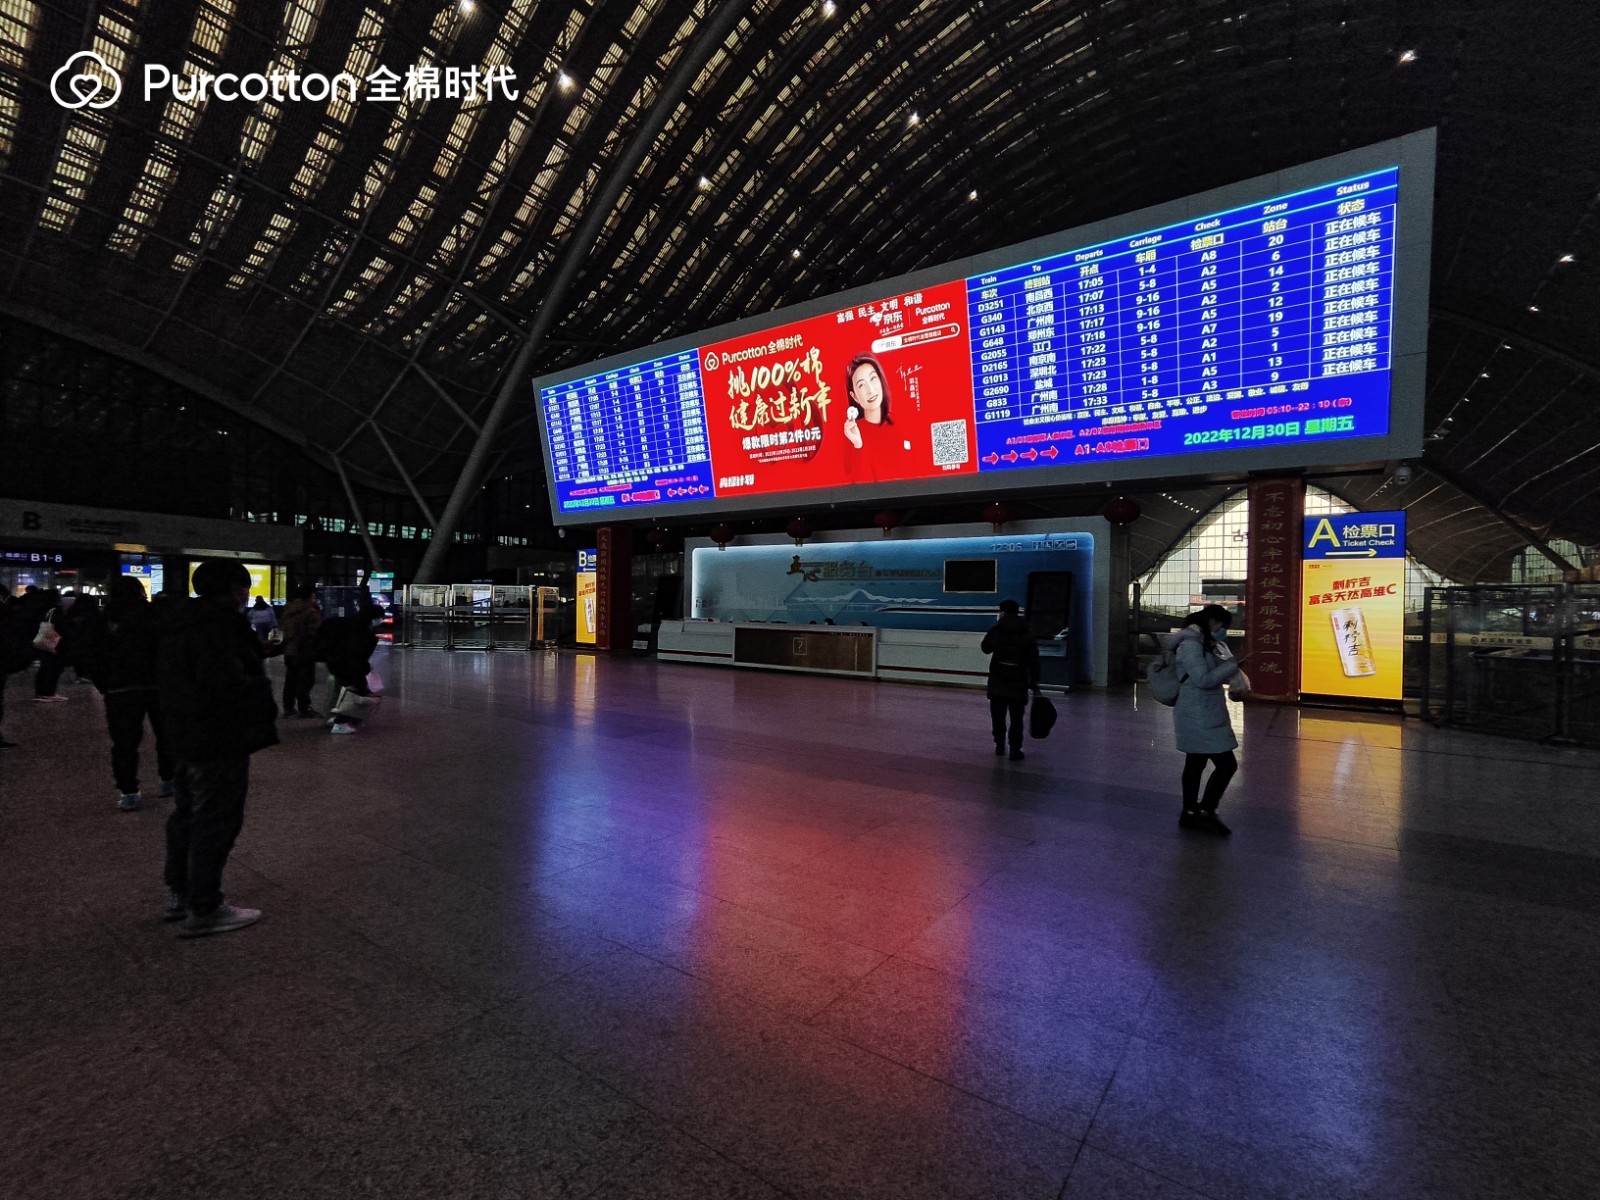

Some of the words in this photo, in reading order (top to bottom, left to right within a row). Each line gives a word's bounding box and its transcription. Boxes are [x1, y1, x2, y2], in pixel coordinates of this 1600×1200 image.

[1076, 250, 1103, 262] Departs
[1130, 235, 1162, 248] Carriage
[1195, 219, 1220, 231] Check
[1264, 203, 1288, 214] Zone
[1337, 182, 1369, 196] Status
[1080, 264, 1099, 277] 开点
[1136, 249, 1156, 263] 车厢
[1191, 233, 1224, 250] 检票口
[1263, 219, 1288, 233] 站台
[1338, 199, 1365, 215] 状态
[978, 300, 1003, 312] D3251
[1078, 276, 1103, 290] 17:05
[1139, 264, 1156, 276] 1-4
[1201, 250, 1217, 262] A8
[1269, 235, 1284, 246] 20
[1325, 212, 1381, 236] 正在候车
[981, 313, 1002, 324] G340
[1079, 290, 1104, 303] 17:07
[1140, 279, 1156, 290] 5-8
[1201, 265, 1216, 277] A2
[1272, 251, 1280, 261] 6
[1325, 229, 1380, 251] 正在候车
[836, 312, 854, 324] 富强
[858, 305, 875, 318] 民主
[881, 299, 898, 312] 文明
[904, 294, 923, 307] 和谐
[916, 302, 951, 316] Purcotton
[980, 324, 1005, 336] G1143
[1080, 304, 1104, 316] 17:13
[1136, 292, 1160, 305] 9-16
[1201, 280, 1216, 291] A5
[1269, 266, 1284, 277] 14
[1324, 245, 1380, 268] 正在候车
[983, 337, 1004, 348] G648
[1080, 317, 1104, 329] 17:17
[1137, 306, 1160, 318] 9-16
[1202, 295, 1217, 306] A2
[1272, 282, 1280, 292] 2
[1324, 262, 1380, 284] 正在候车
[884, 312, 903, 325] 京东
[981, 349, 1007, 360] G2055
[1080, 330, 1105, 342] 17:18
[1137, 320, 1160, 332] 9-16
[1202, 309, 1217, 320] A5
[1269, 296, 1283, 307] 12
[1324, 278, 1379, 299] 正在候车
[982, 361, 1008, 372] D2165
[1081, 344, 1106, 355] 17:22
[1141, 334, 1157, 345] 5-8
[1202, 324, 1217, 334] A7
[1269, 312, 1283, 322] 19
[1324, 294, 1378, 314] 正在候车
[722, 344, 767, 366] Purcotton
[768, 334, 804, 355] 全棉时代
[983, 374, 1008, 384] G1013
[1082, 357, 1106, 368] 17:23
[1141, 348, 1158, 359] 5-8
[1202, 338, 1217, 349] A2
[1272, 327, 1279, 337] 5
[1324, 311, 1378, 330] 正在候车
[984, 386, 1009, 396] G2690
[1082, 370, 1106, 381] 17:23
[1142, 362, 1158, 372] 5-8
[1202, 352, 1216, 363] A1
[1272, 342, 1278, 352] 1
[1323, 326, 1378, 345] 正在候车
[727, 346, 823, 400] 挑100%棉
[985, 410, 1010, 420] G1119
[1083, 396, 1108, 406] 17:33
[1142, 389, 1158, 399] 5-8
[1202, 380, 1218, 390] A3
[1271, 372, 1279, 381] 9
[1322, 358, 1376, 376] 正在候车
[986, 398, 1007, 408] G833
[1083, 383, 1107, 394] 17:28
[1142, 376, 1158, 386] 1-8
[1202, 366, 1217, 377] A5
[1268, 357, 1282, 367] 13
[1323, 342, 1377, 361] 正在候车
[729, 382, 832, 431] 健康过新年
[1184, 422, 1300, 445] 2022年12月30日
[1304, 416, 1354, 434] 星期五
[742, 428, 822, 451] 爆款限时第2件0元
[24, 511, 40, 530] B
[1308, 518, 1340, 548] A
[1342, 524, 1395, 539] 检票口
[1342, 540, 1367, 548] Ticket
[30, 553, 63, 563] B1-8
[578, 551, 587, 567] B
[824, 560, 874, 578] 服务台
[1258, 492, 1284, 675] 不忘初心牢记使命服务创一流
[1308, 583, 1397, 606] 富含天然高维C
[1332, 577, 1371, 591] 刺柠吉
